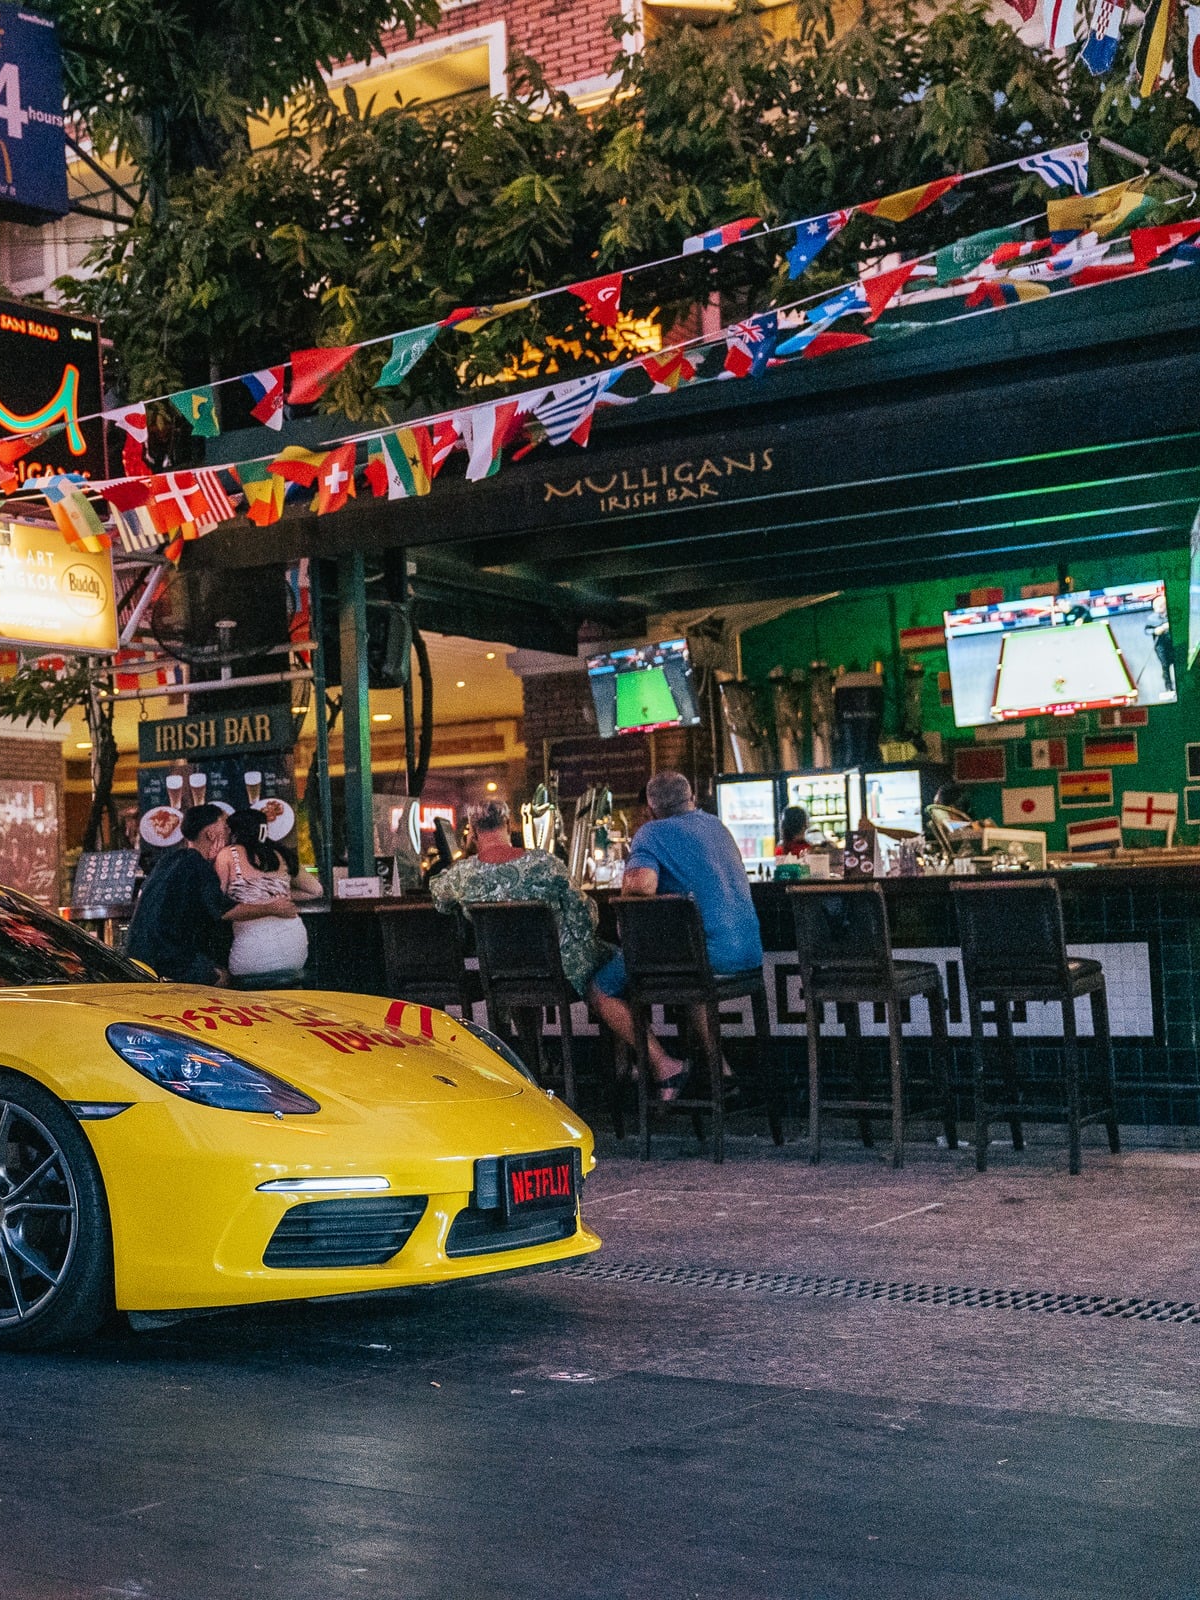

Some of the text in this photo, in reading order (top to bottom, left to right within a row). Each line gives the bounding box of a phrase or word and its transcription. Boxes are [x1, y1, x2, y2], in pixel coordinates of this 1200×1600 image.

[28, 106, 63, 127] hours
[0, 314, 27, 334] SAN
[27, 320, 60, 342] ROAD
[544, 448, 774, 502] MULLIGANS
[600, 482, 718, 512] IRISH BAR
[26, 549, 55, 568] ART
[69, 572, 100, 599] Buddy
[155, 714, 271, 752] IRISH BAR
[511, 1164, 570, 1204] NETFLIX
